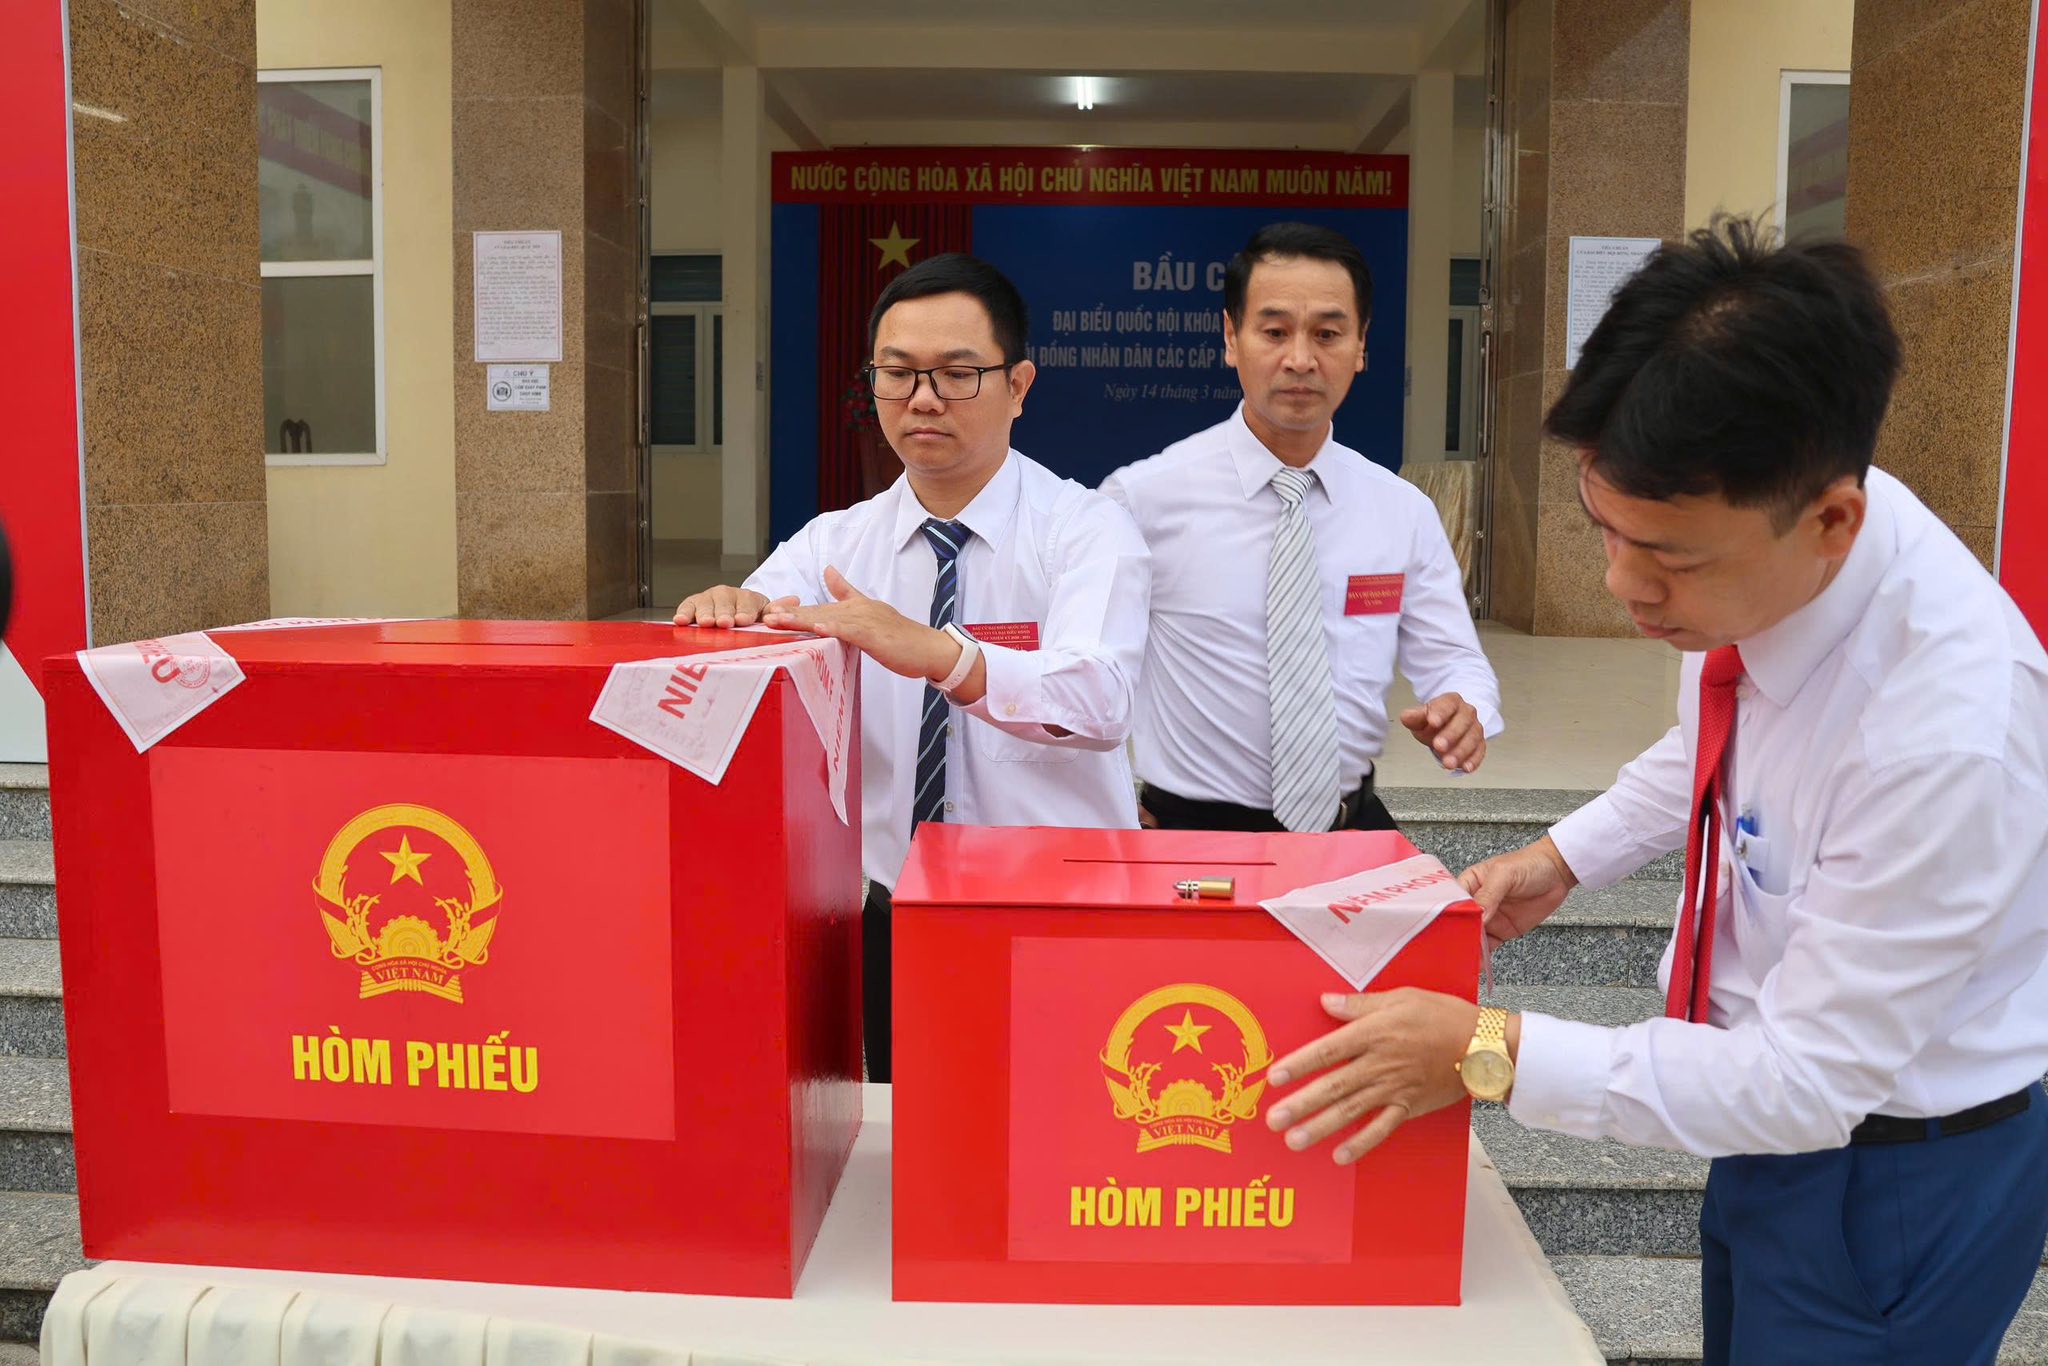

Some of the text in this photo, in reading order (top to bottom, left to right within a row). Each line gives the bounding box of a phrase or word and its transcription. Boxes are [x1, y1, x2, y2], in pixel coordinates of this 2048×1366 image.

[790, 158, 1392, 198] NƯỚC CỘNG HÒA XÃ HỘI CHỦ NGHĨA VIỆT NAM MUÔN NĂM!
[1133, 251, 1228, 292] BẦU C
[1052, 302, 1221, 337] ĐẠI BIỂU QUỐC HỘI KHÓA
[1039, 339, 1077, 368] ĐỒNG
[1081, 342, 1120, 368] NHÂN
[1124, 342, 1152, 368] DÂN
[1156, 343, 1185, 368] CÁC
[1188, 340, 1216, 368] CẤP
[1103, 383, 1243, 403] Ngày 14 tháng 3 năm
[412, 966, 444, 984] NAM
[292, 1025, 539, 1093] HÒM PHIẾU
[1070, 1174, 1295, 1228] HÒM PHIẾU
